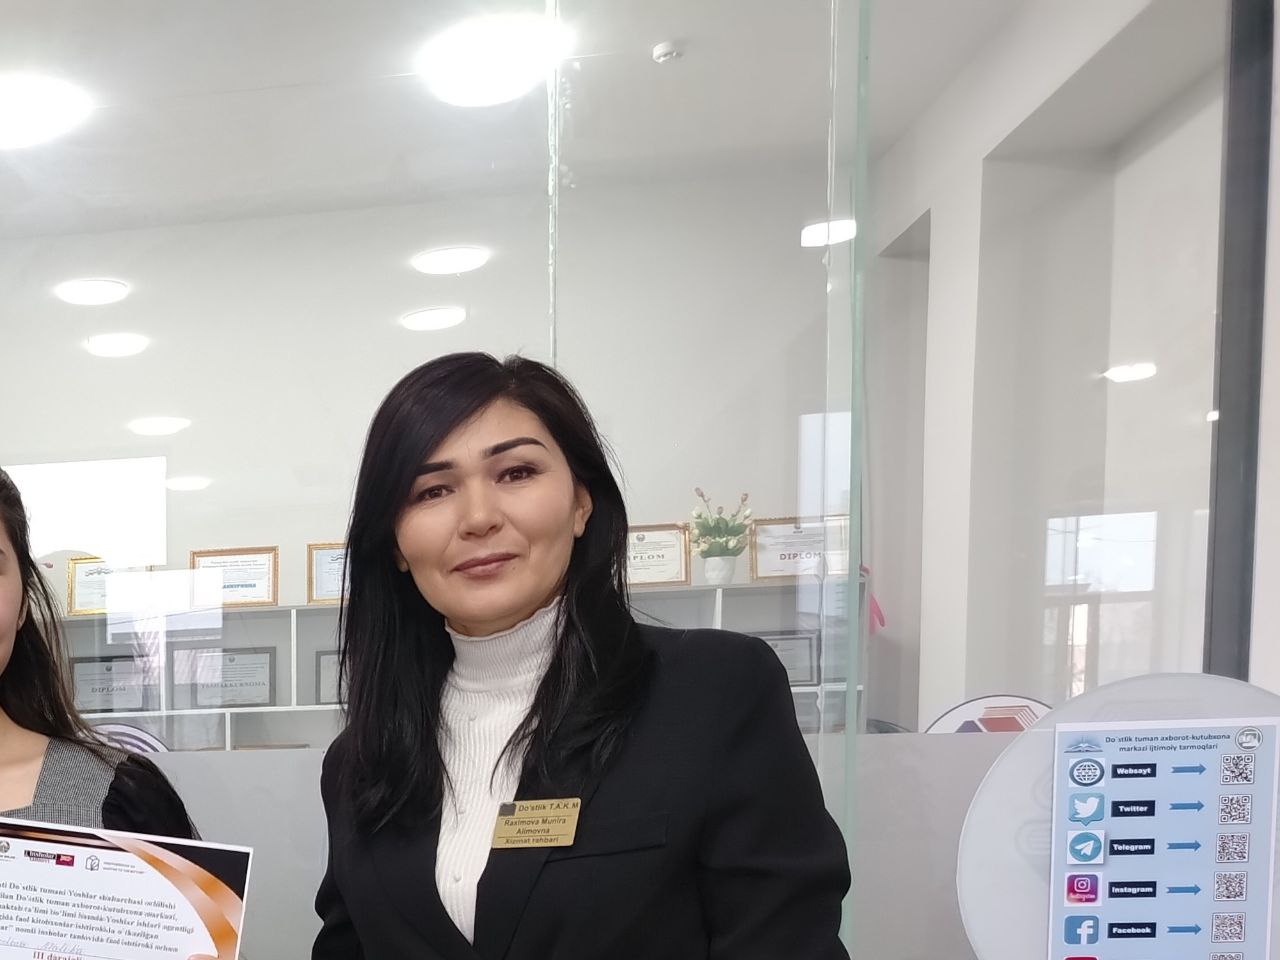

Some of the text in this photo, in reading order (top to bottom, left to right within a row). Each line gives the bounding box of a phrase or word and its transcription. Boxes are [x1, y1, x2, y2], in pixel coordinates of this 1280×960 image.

[779, 551, 823, 561] DIPLOM
[1179, 744, 1218, 752] tarmoqlari
[1116, 766, 1152, 776] Websayt
[1118, 804, 1148, 813] Twitter
[504, 817, 567, 827] Raximova Munira
[516, 827, 551, 835] Alimovna
[1112, 842, 1152, 853] Telegram
[40, 886, 66, 896] tumani
[68, 890, 97, 900] Yoshlar
[1111, 885, 1153, 894] Instagram
[46, 899, 70, 907] tuman
[15, 915, 29, 923] faol
[106, 916, 135, 926] Yoshlar
[136, 920, 161, 929] ishlari
[15, 925, 36, 934] nomli
[38, 928, 67, 938] insholar
[106, 937, 120, 945] faol
[1112, 926, 1152, 935] Facebook
[33, 951, 45, 960] III
